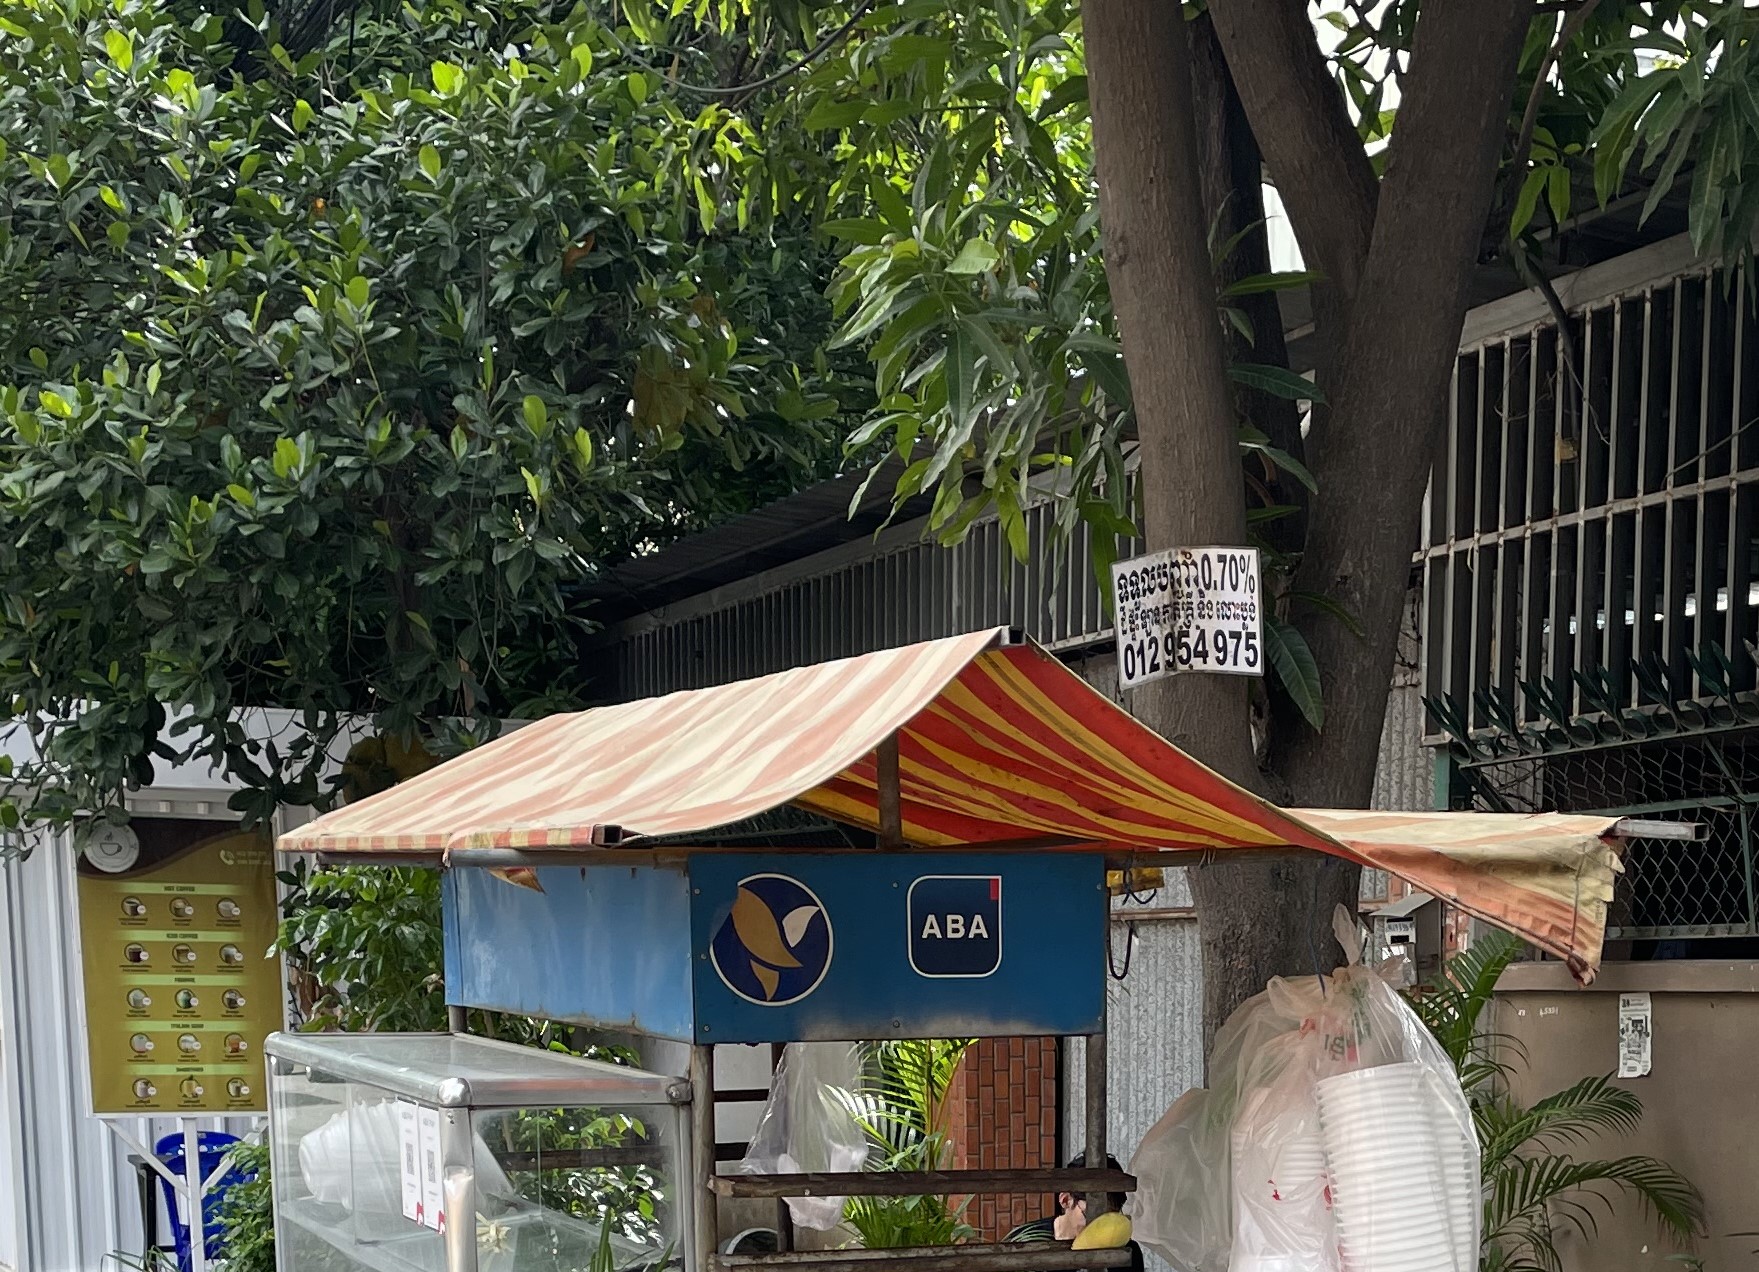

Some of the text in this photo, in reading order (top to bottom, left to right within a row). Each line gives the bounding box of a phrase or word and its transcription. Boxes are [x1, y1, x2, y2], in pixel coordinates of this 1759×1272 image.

[1201, 553, 1256, 594] 0.70%
[1124, 628, 1258, 681] 012 954 975
[922, 914, 989, 939] ABA
